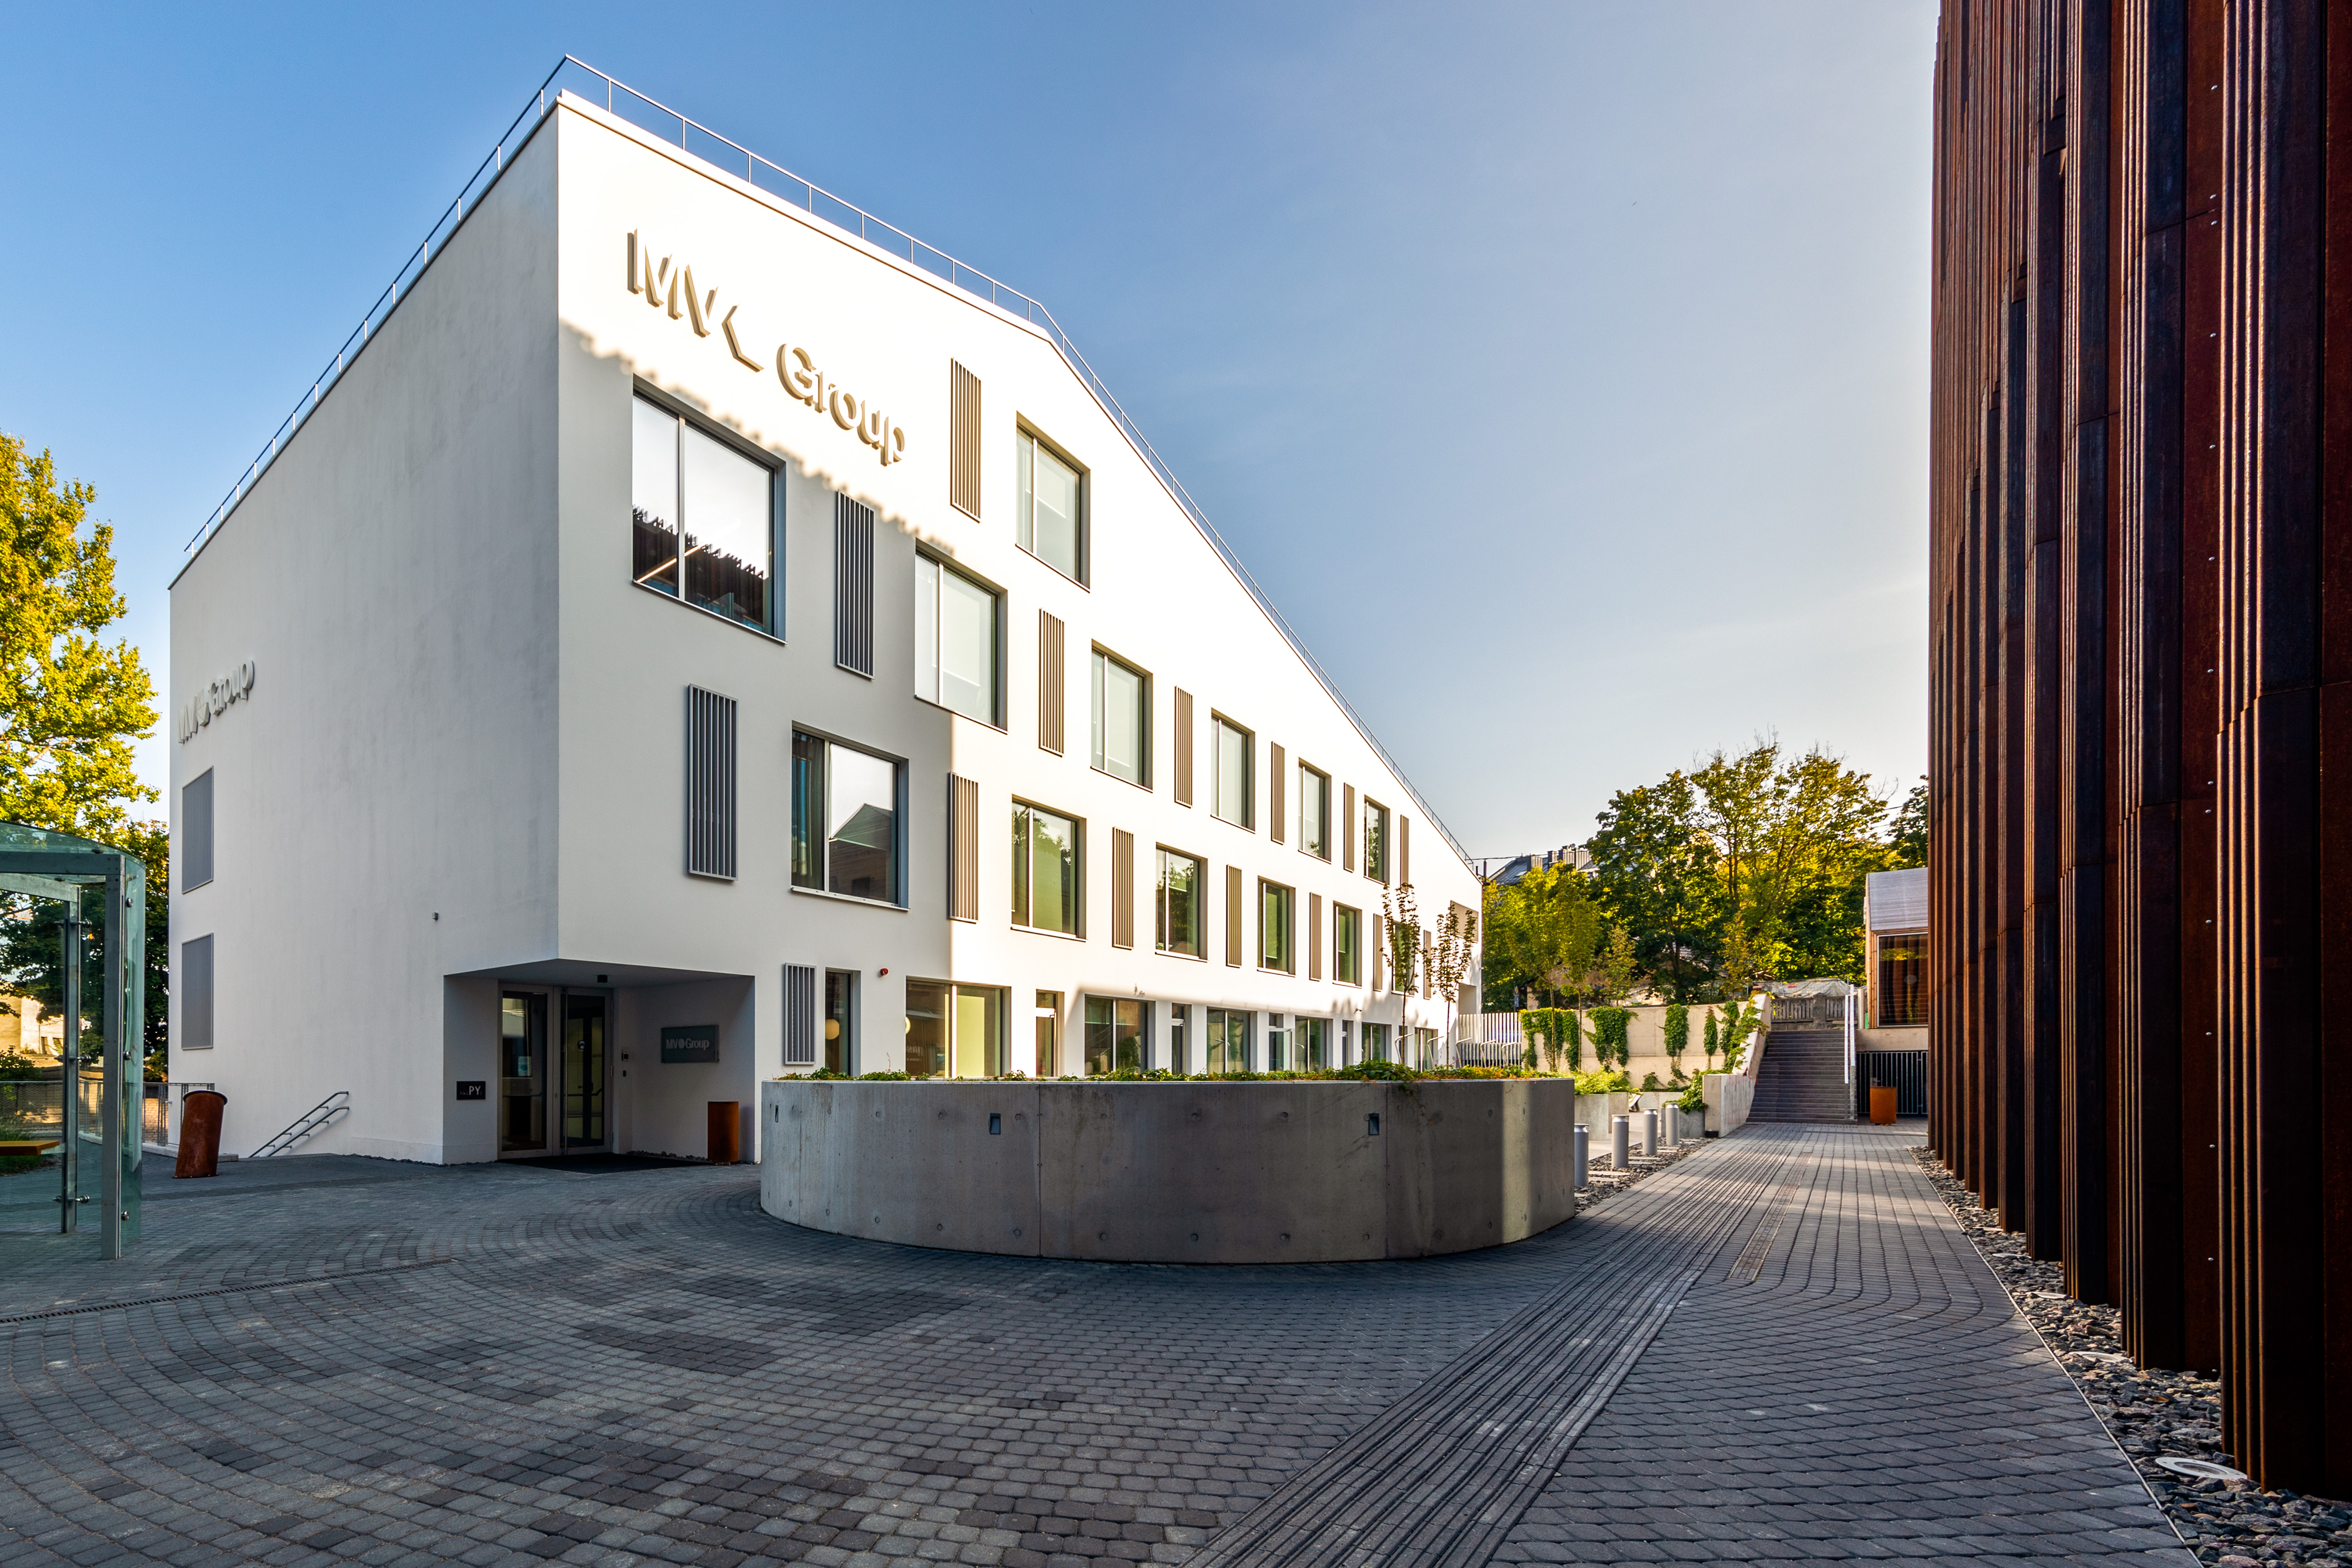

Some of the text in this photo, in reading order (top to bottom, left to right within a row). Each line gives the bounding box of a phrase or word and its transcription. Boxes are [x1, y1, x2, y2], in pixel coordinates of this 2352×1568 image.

[777, 343, 904, 467] Group
[208, 660, 254, 716] Group
[686, 1038, 710, 1050] Group
